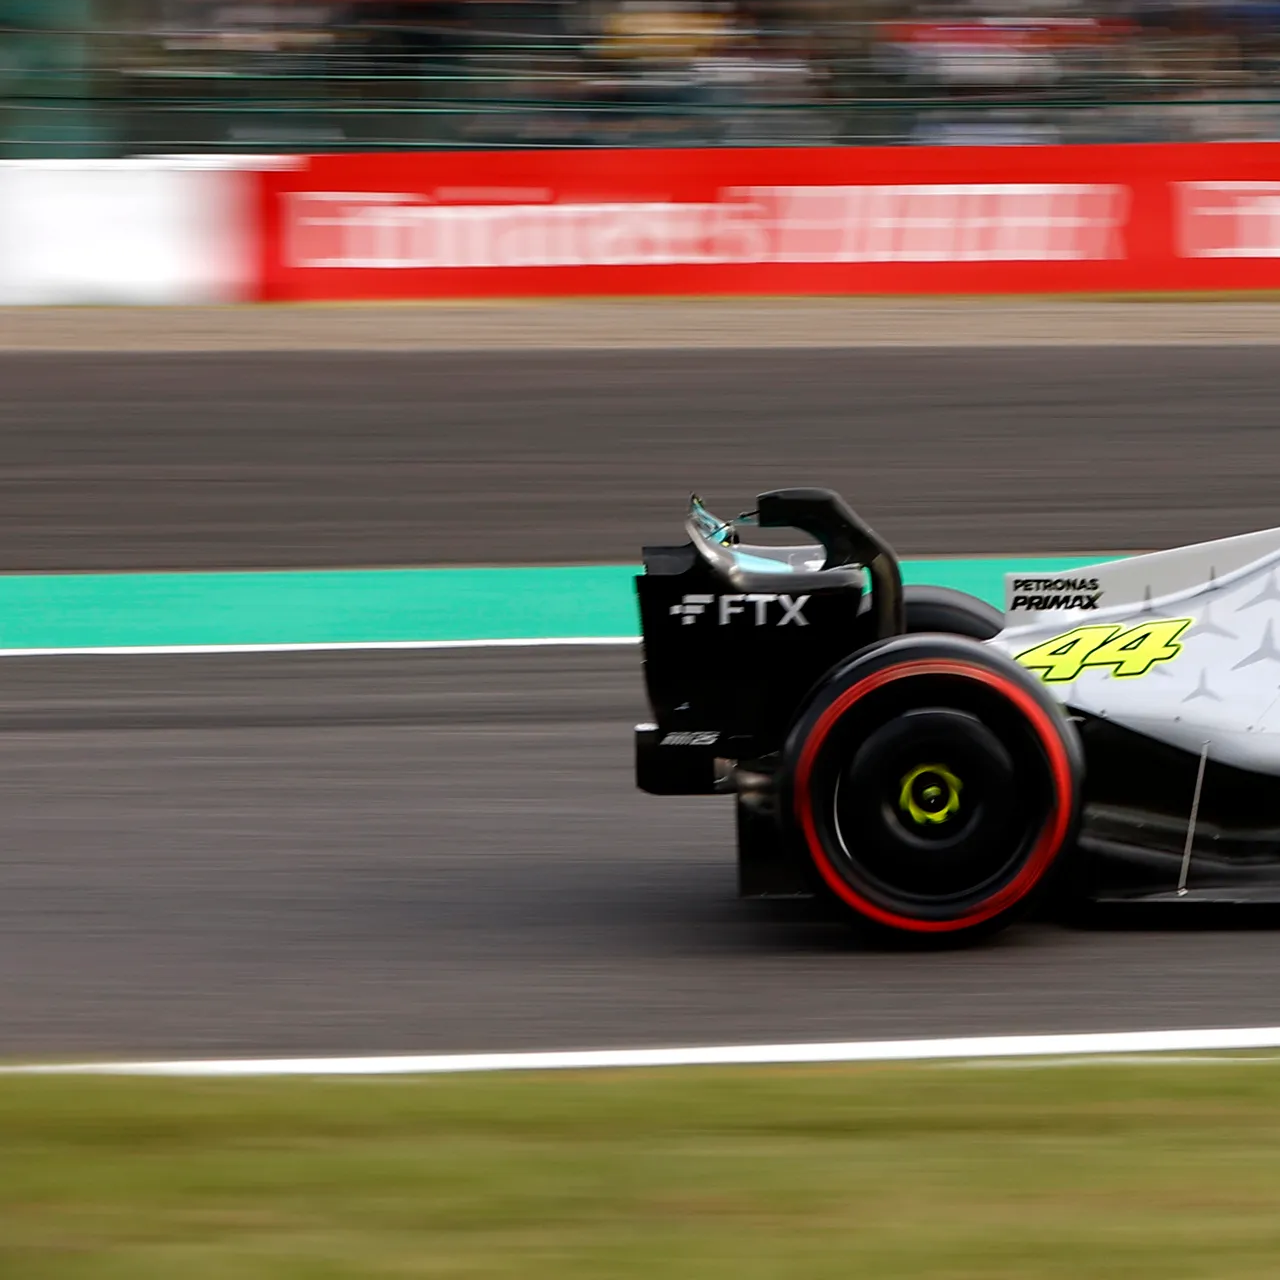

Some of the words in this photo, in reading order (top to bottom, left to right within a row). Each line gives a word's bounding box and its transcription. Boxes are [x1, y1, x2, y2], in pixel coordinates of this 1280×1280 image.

[1013, 578, 1100, 592] PETRONAS
[718, 593, 812, 626] FTX
[1010, 592, 1104, 611] PRIMAX
[1013, 618, 1196, 683] 44
